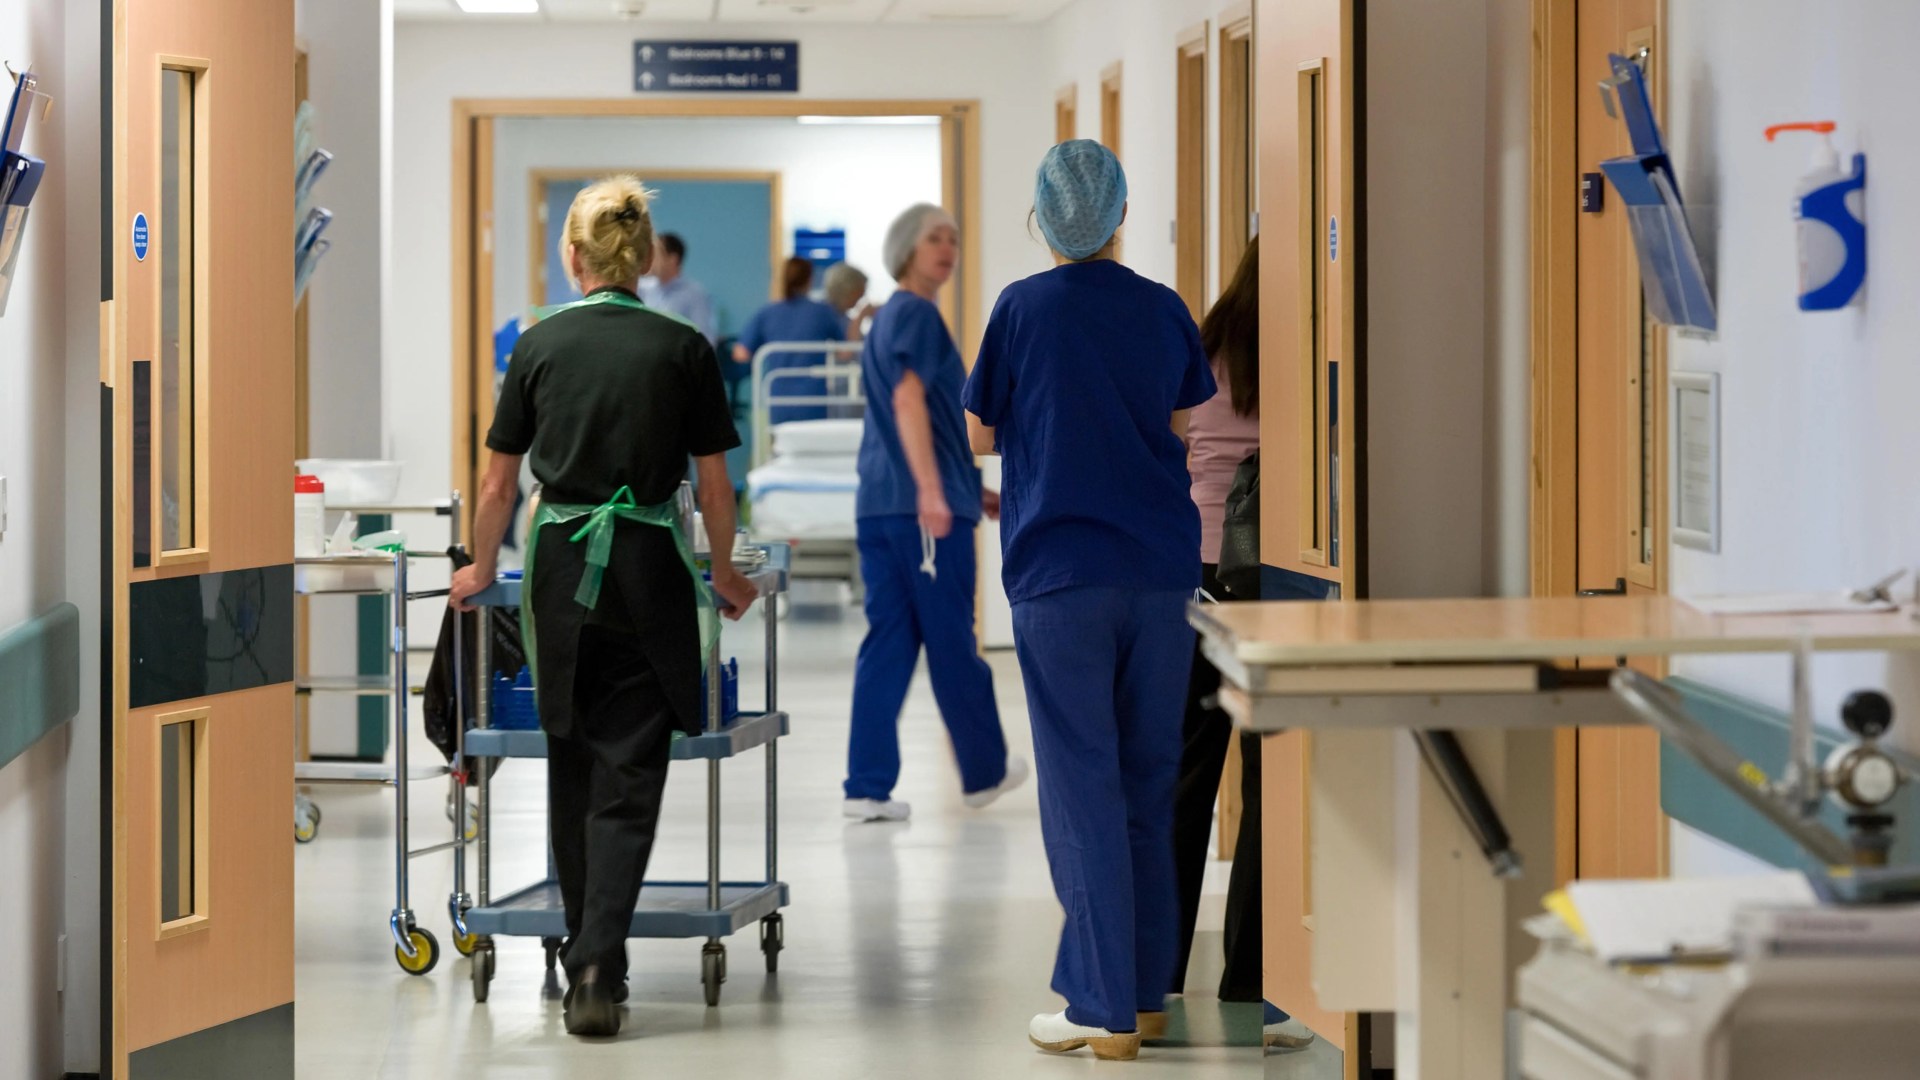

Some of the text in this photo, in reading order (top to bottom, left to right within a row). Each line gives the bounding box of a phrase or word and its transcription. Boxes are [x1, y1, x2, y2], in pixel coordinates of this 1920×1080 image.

[668, 47, 723, 60] Bedrooms
[726, 47, 750, 60] Blue
[668, 73, 723, 87] Bedrooms
[725, 73, 749, 87] Red
